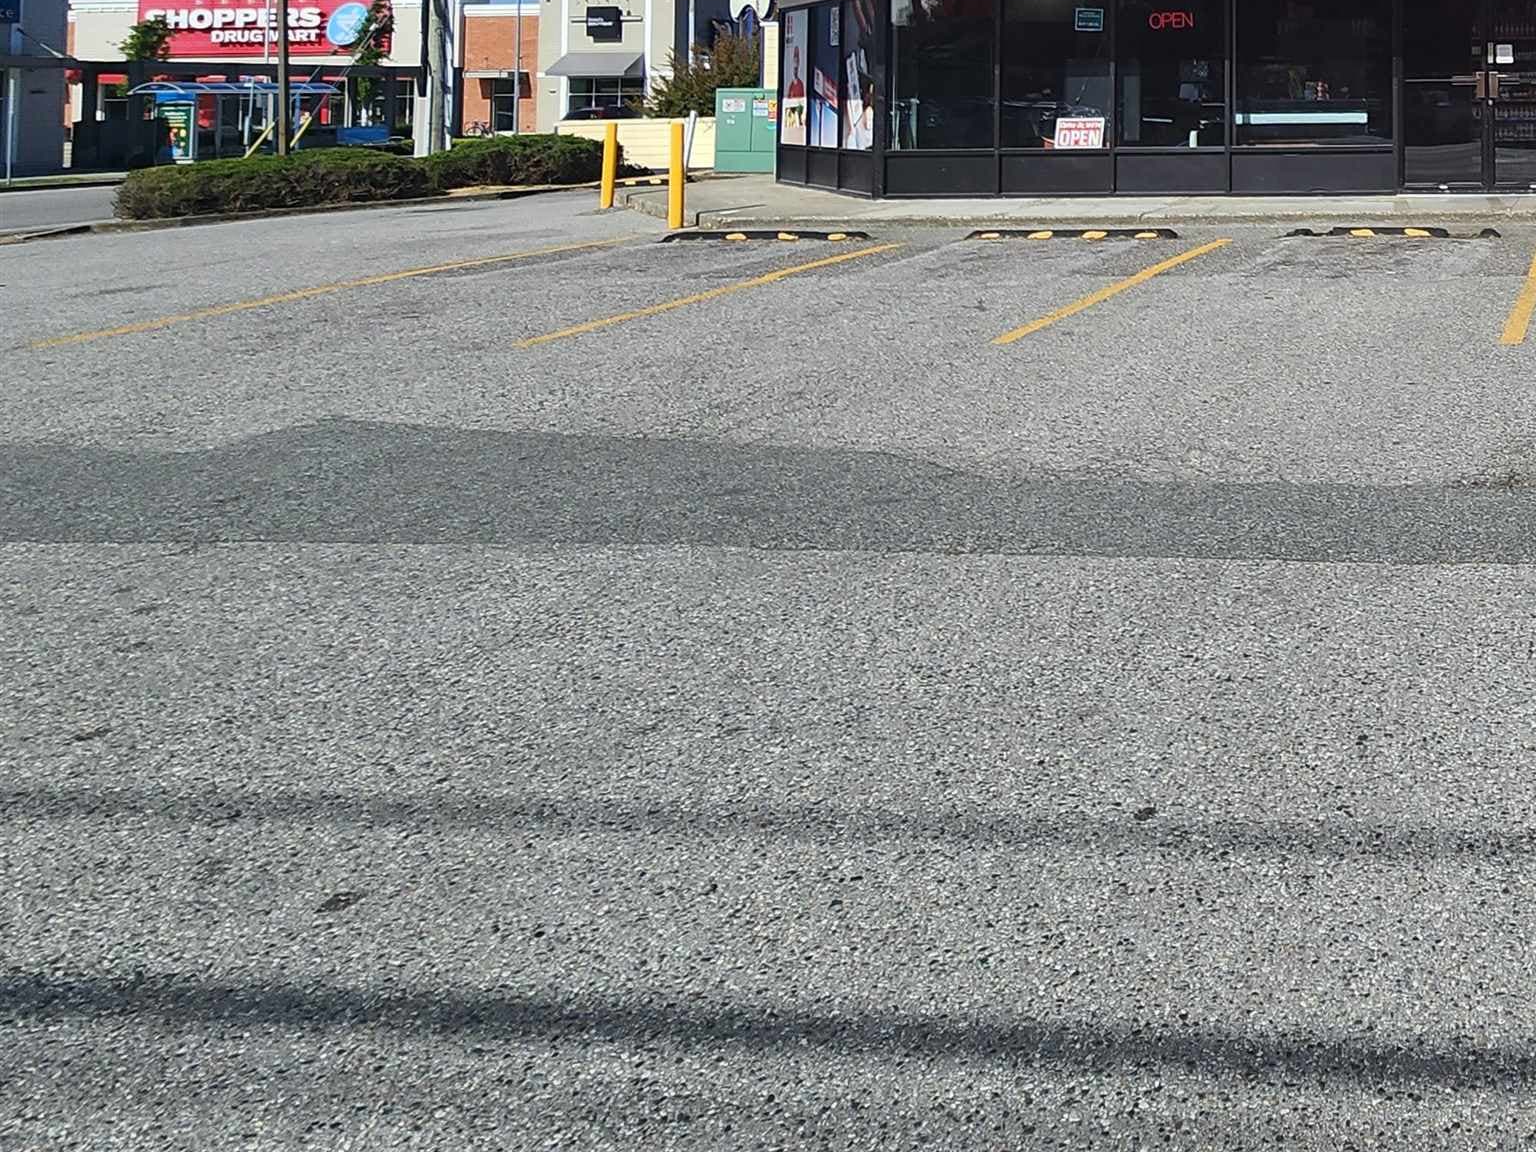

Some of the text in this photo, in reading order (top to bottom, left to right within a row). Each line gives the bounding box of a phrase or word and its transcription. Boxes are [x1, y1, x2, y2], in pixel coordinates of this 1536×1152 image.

[1149, 12, 1194, 29] OPEN
[210, 29, 263, 43] DRUG
[1059, 129, 1100, 146] OPEN
